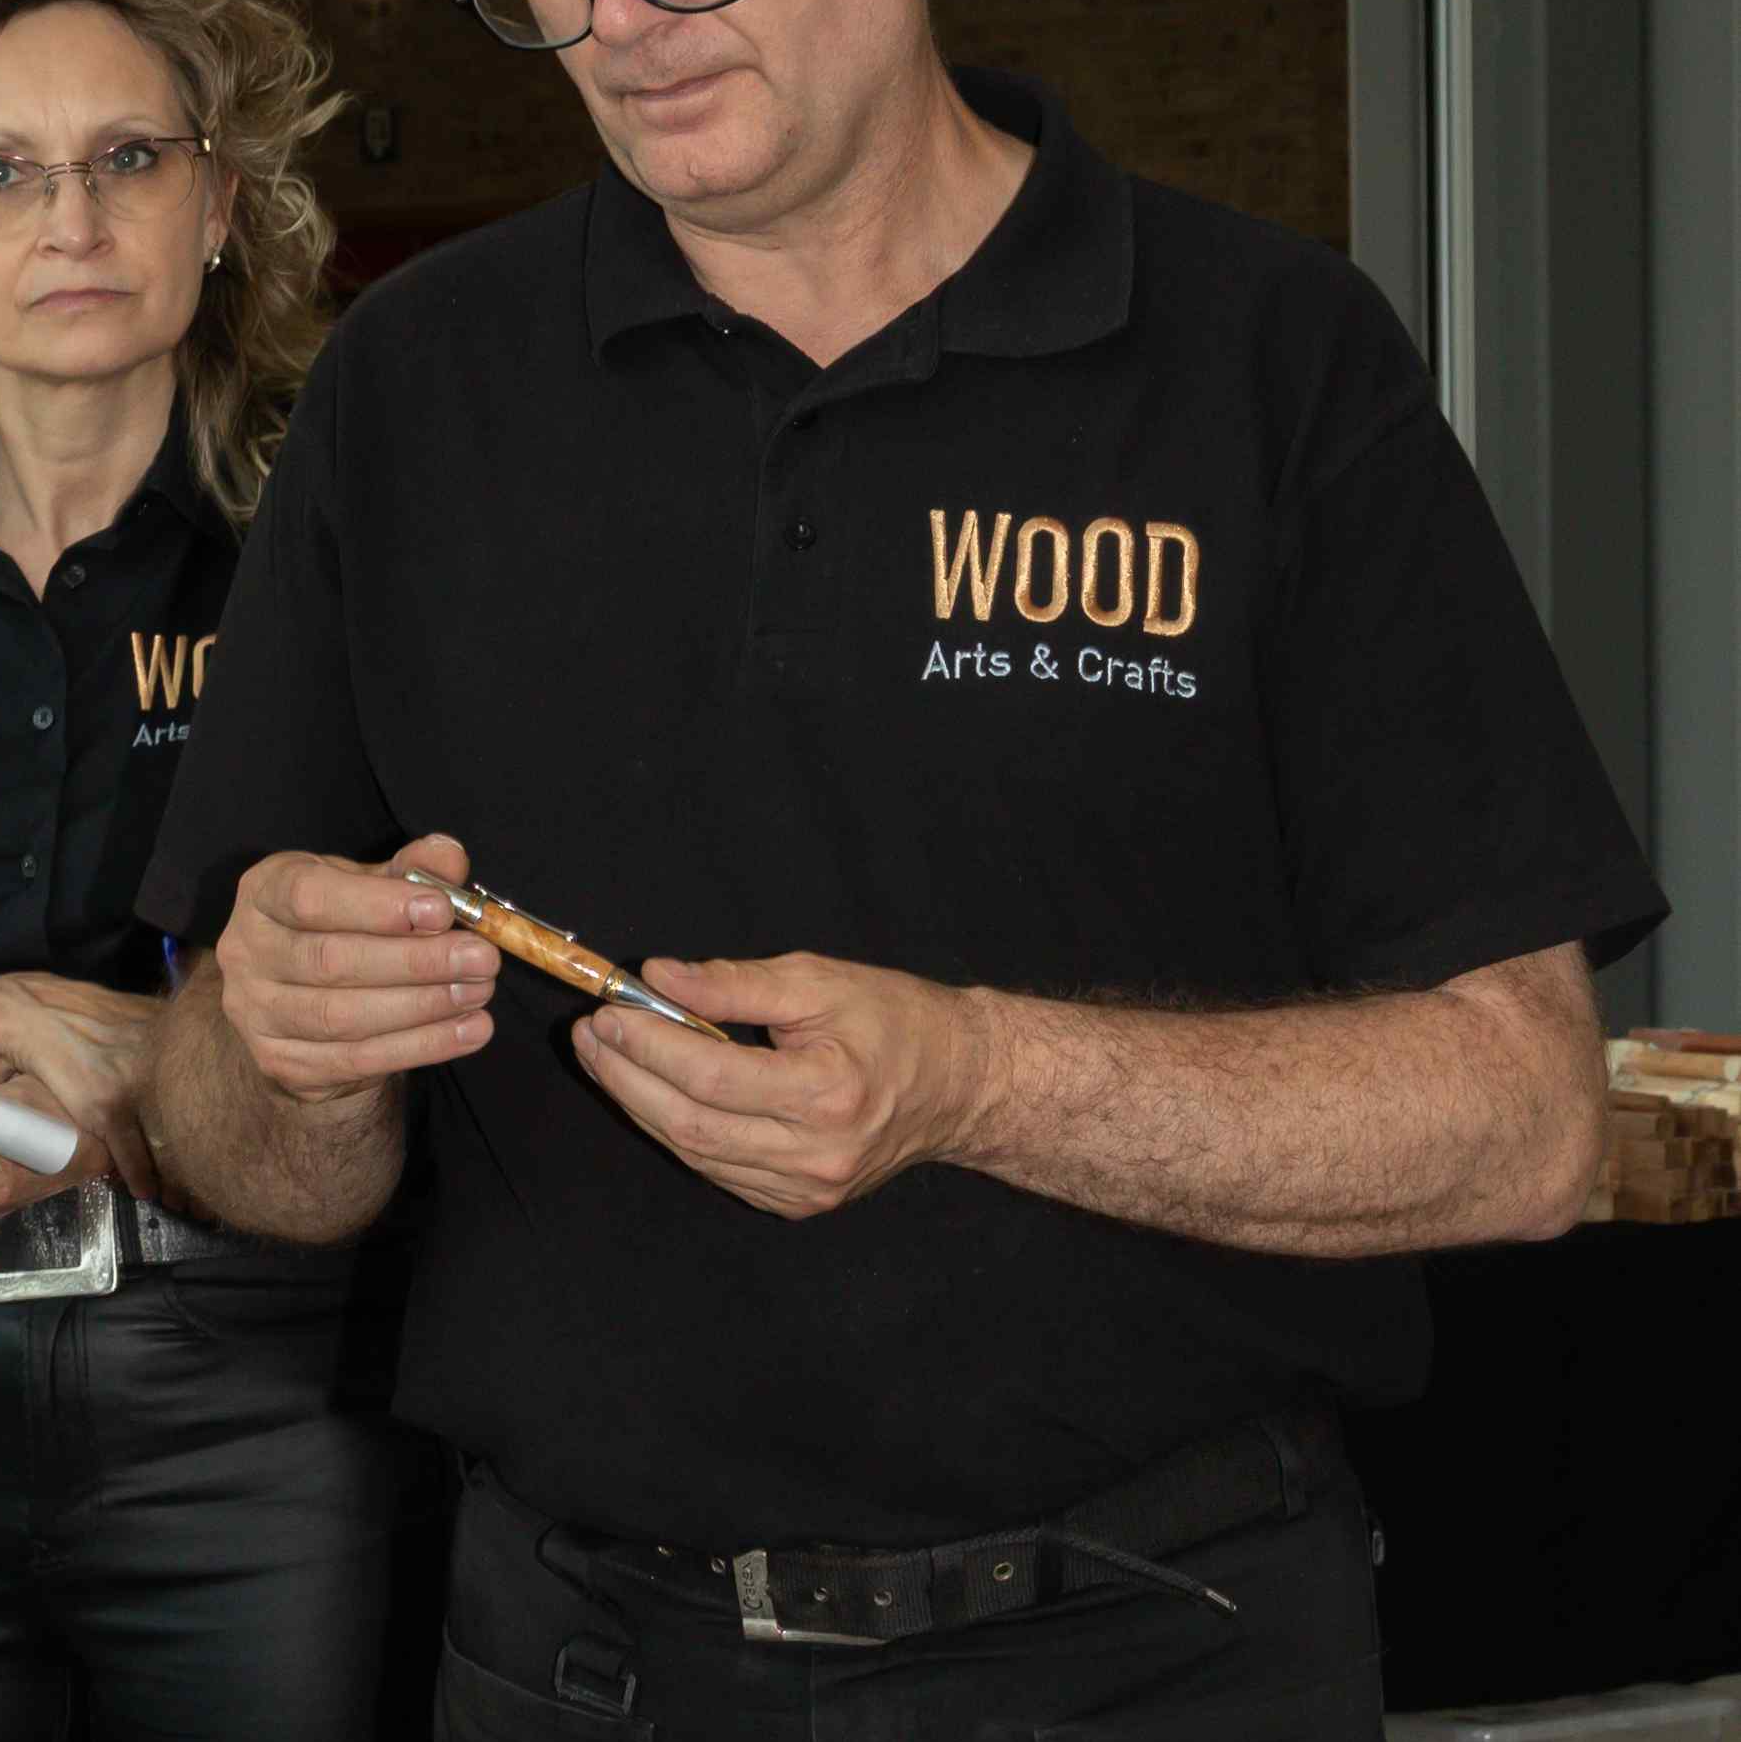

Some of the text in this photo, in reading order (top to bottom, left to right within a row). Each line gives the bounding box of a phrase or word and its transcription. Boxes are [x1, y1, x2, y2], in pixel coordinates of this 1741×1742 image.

[929, 508, 1200, 637] WOOD
[921, 640, 1198, 699] Arts & Crafts
[131, 720, 192, 747] Arts
